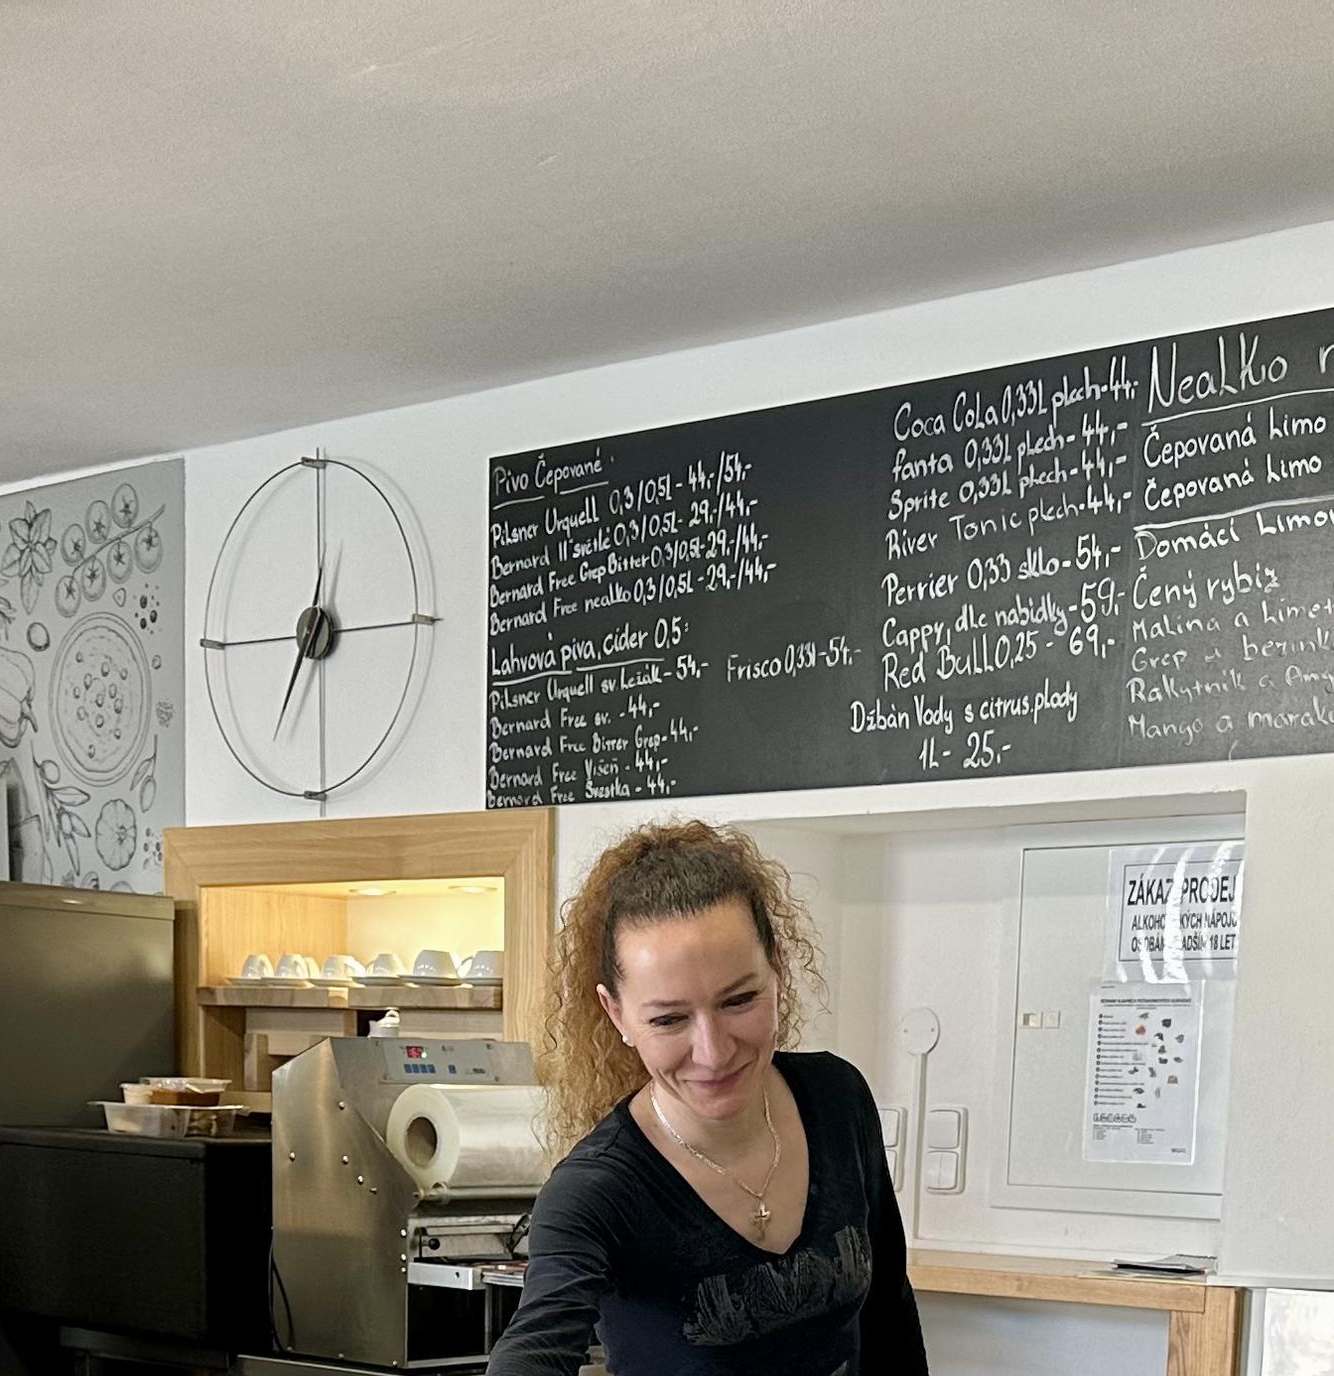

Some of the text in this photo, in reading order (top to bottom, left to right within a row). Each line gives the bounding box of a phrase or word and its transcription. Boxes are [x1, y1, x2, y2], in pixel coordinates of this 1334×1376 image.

[893, 401, 946, 441] Coca
[1143, 410, 1257, 469] Čepovaná
[493, 465, 529, 496] Pivo
[1144, 458, 1255, 511] Čepovaná
[490, 520, 539, 549] Pilsner
[544, 495, 600, 539] Urquell
[888, 488, 951, 523] Sprite
[885, 528, 938, 561] River
[948, 507, 1023, 542] Tonic
[490, 544, 551, 581] Bernard
[489, 575, 545, 609] Bernard
[548, 570, 577, 593] Free
[881, 571, 959, 607] Perrier
[489, 600, 548, 637] Bernard
[553, 596, 579, 618] Free
[1132, 613, 1221, 644] Malina
[1234, 611, 1250, 628] a
[491, 631, 557, 676] Lahvová
[727, 653, 782, 683] Frisco
[881, 650, 927, 693] Red
[935, 633, 995, 681] Bull
[490, 689, 541, 714] Pilsner
[546, 673, 594, 704] Urquell
[489, 707, 552, 741] Bernard
[560, 706, 588, 729] Free
[964, 702, 975, 724] s
[1127, 713, 1204, 747] Mango
[1216, 714, 1234, 733] a
[488, 736, 553, 764] Bernard
[487, 764, 544, 791] Bernard
[1127, 873, 1174, 906] ZÁKAZ
[1219, 933, 1237, 951] LET
